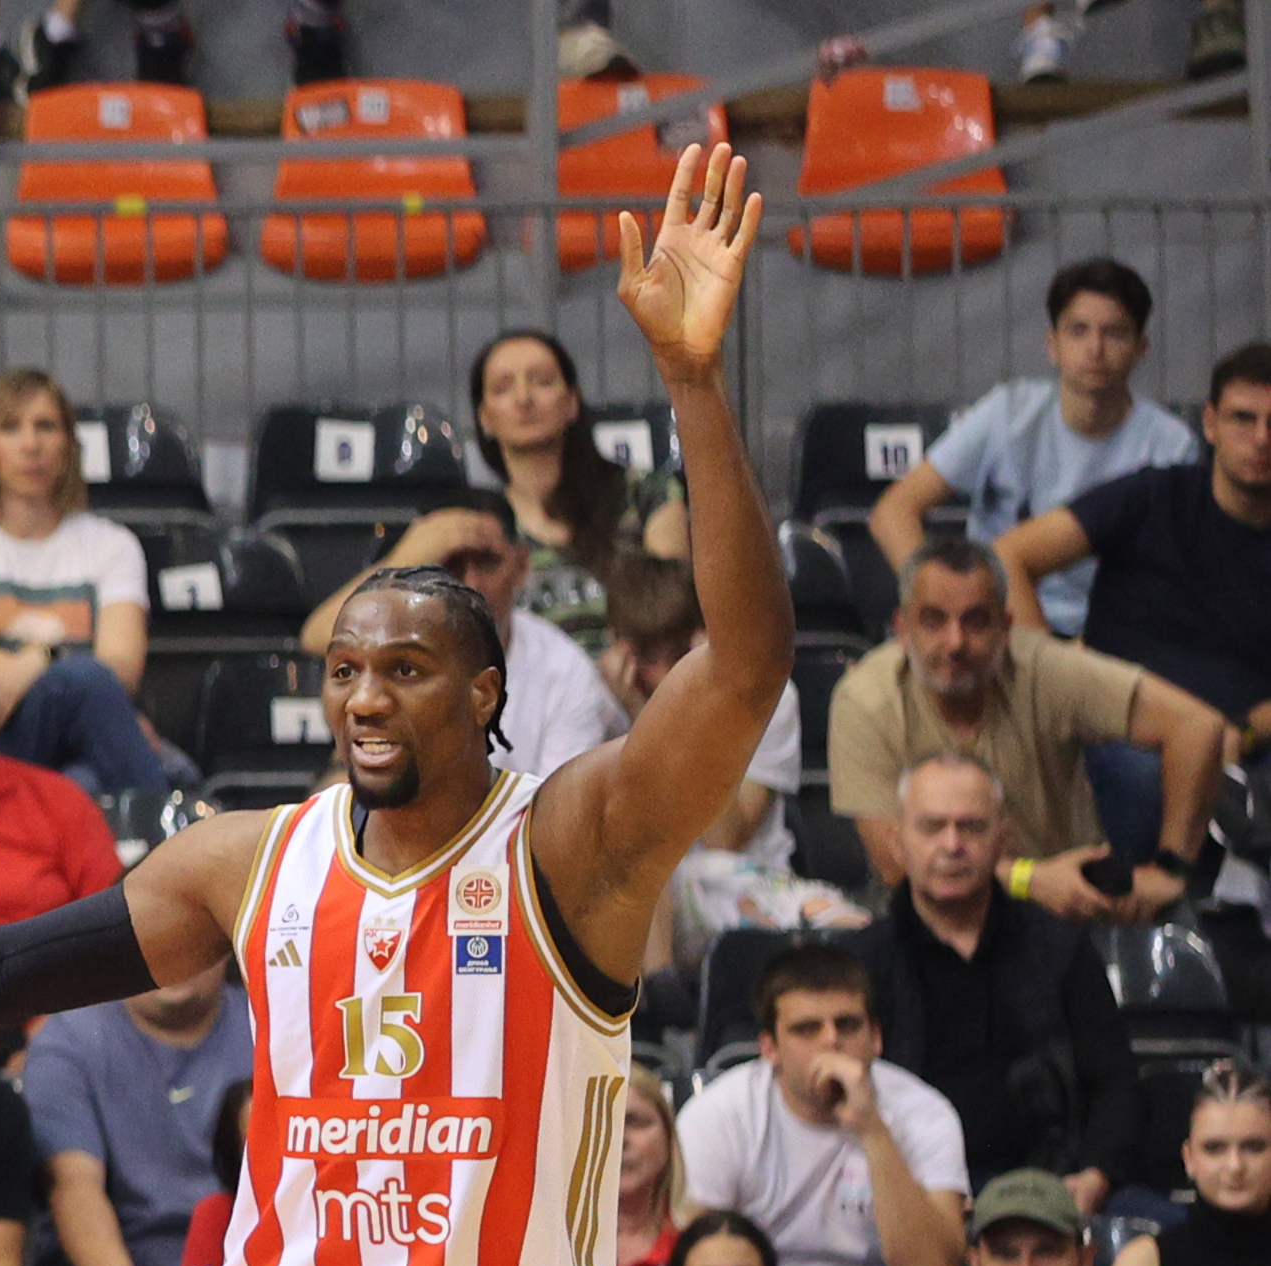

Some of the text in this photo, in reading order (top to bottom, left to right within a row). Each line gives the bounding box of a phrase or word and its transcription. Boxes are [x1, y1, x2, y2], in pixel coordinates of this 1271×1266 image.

[334, 991, 427, 1081] 15
[287, 1104, 493, 1155] meridian
[313, 1177, 453, 1246] mts
